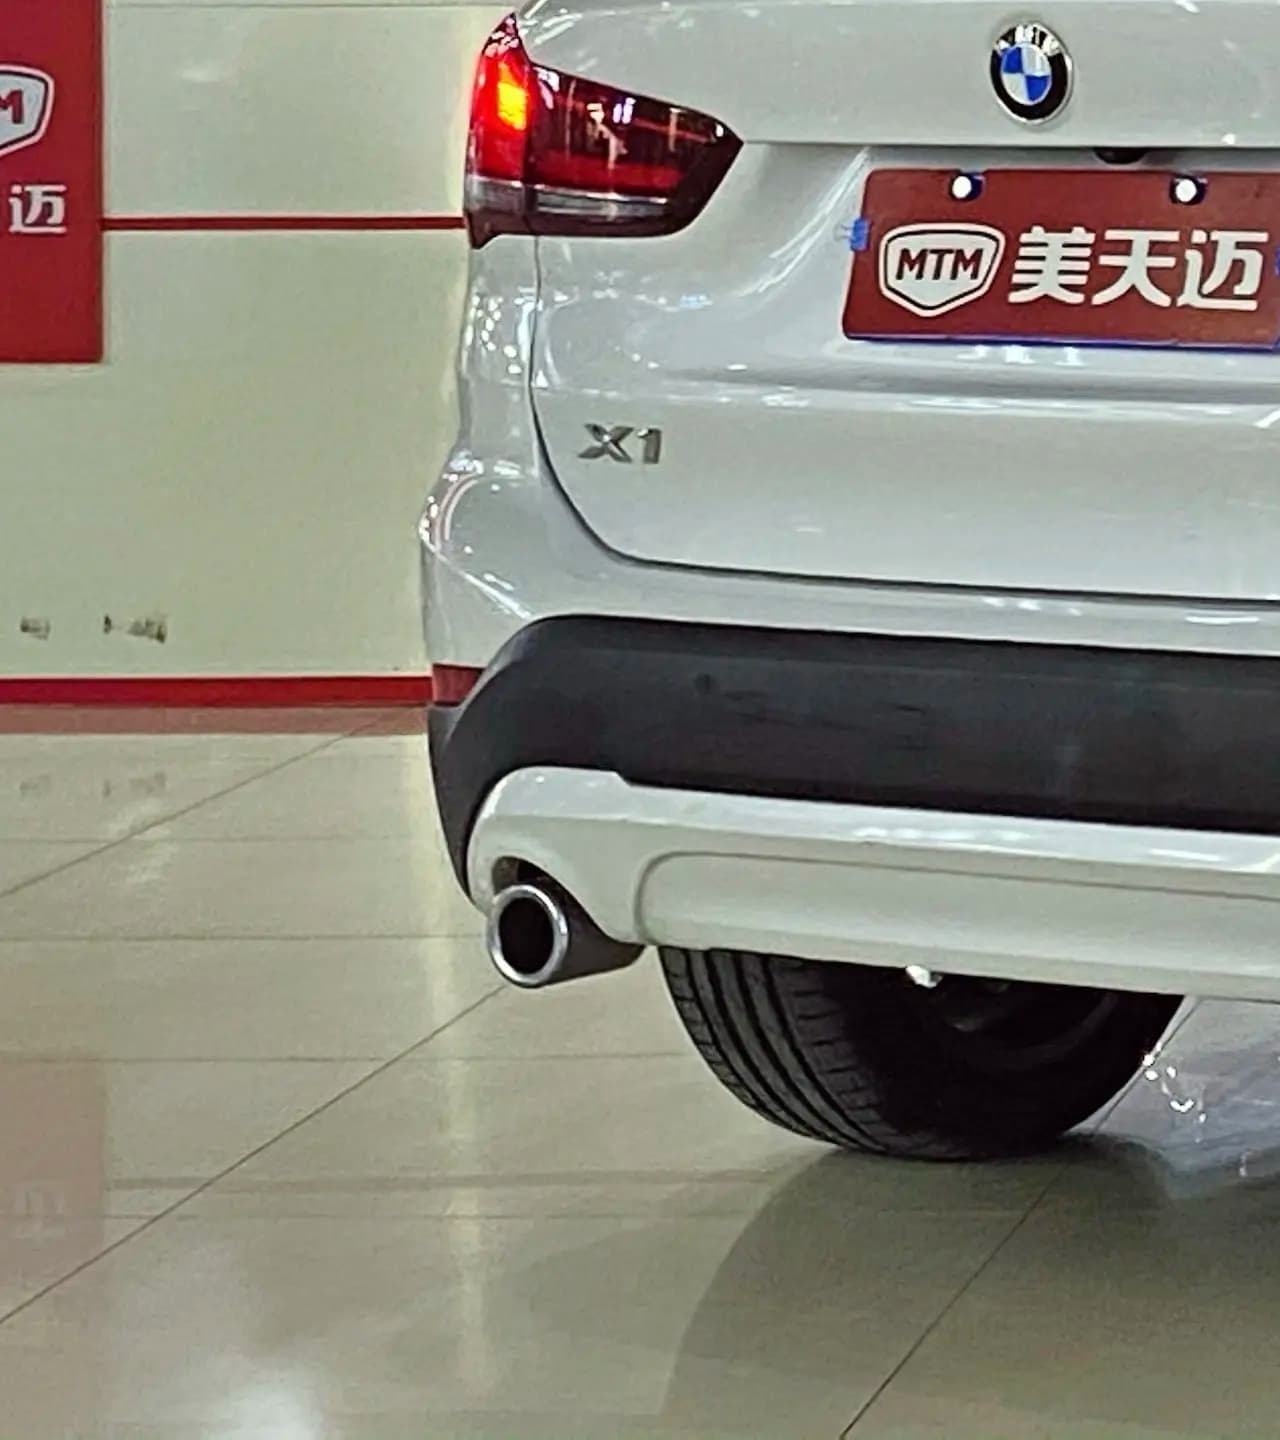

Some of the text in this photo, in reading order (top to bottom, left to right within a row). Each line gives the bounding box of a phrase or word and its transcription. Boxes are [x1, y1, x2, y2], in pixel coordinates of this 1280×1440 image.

[8, 184, 67, 234] 迈
[895, 246, 984, 281] MTM
[1008, 226, 1269, 312] 美天迈
[578, 424, 662, 464] X1
